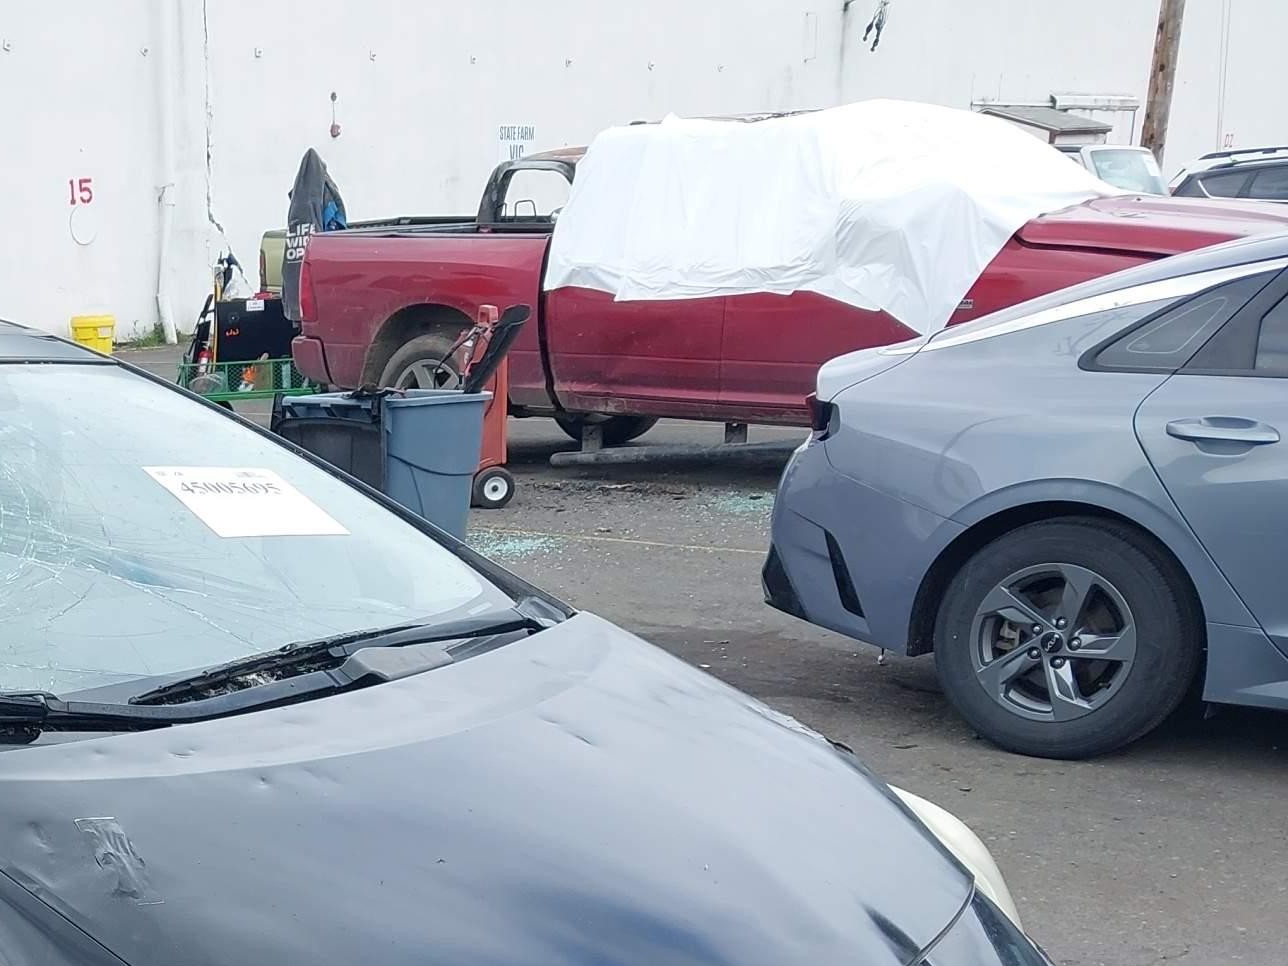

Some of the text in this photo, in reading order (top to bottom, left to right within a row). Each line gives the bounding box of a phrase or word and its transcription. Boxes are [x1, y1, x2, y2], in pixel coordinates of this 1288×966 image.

[500, 126, 535, 141] STATE FARM
[69, 178, 93, 205] 15
[286, 235, 310, 248] WID
[286, 247, 305, 260] OP
[181, 481, 281, 495] 45005695
